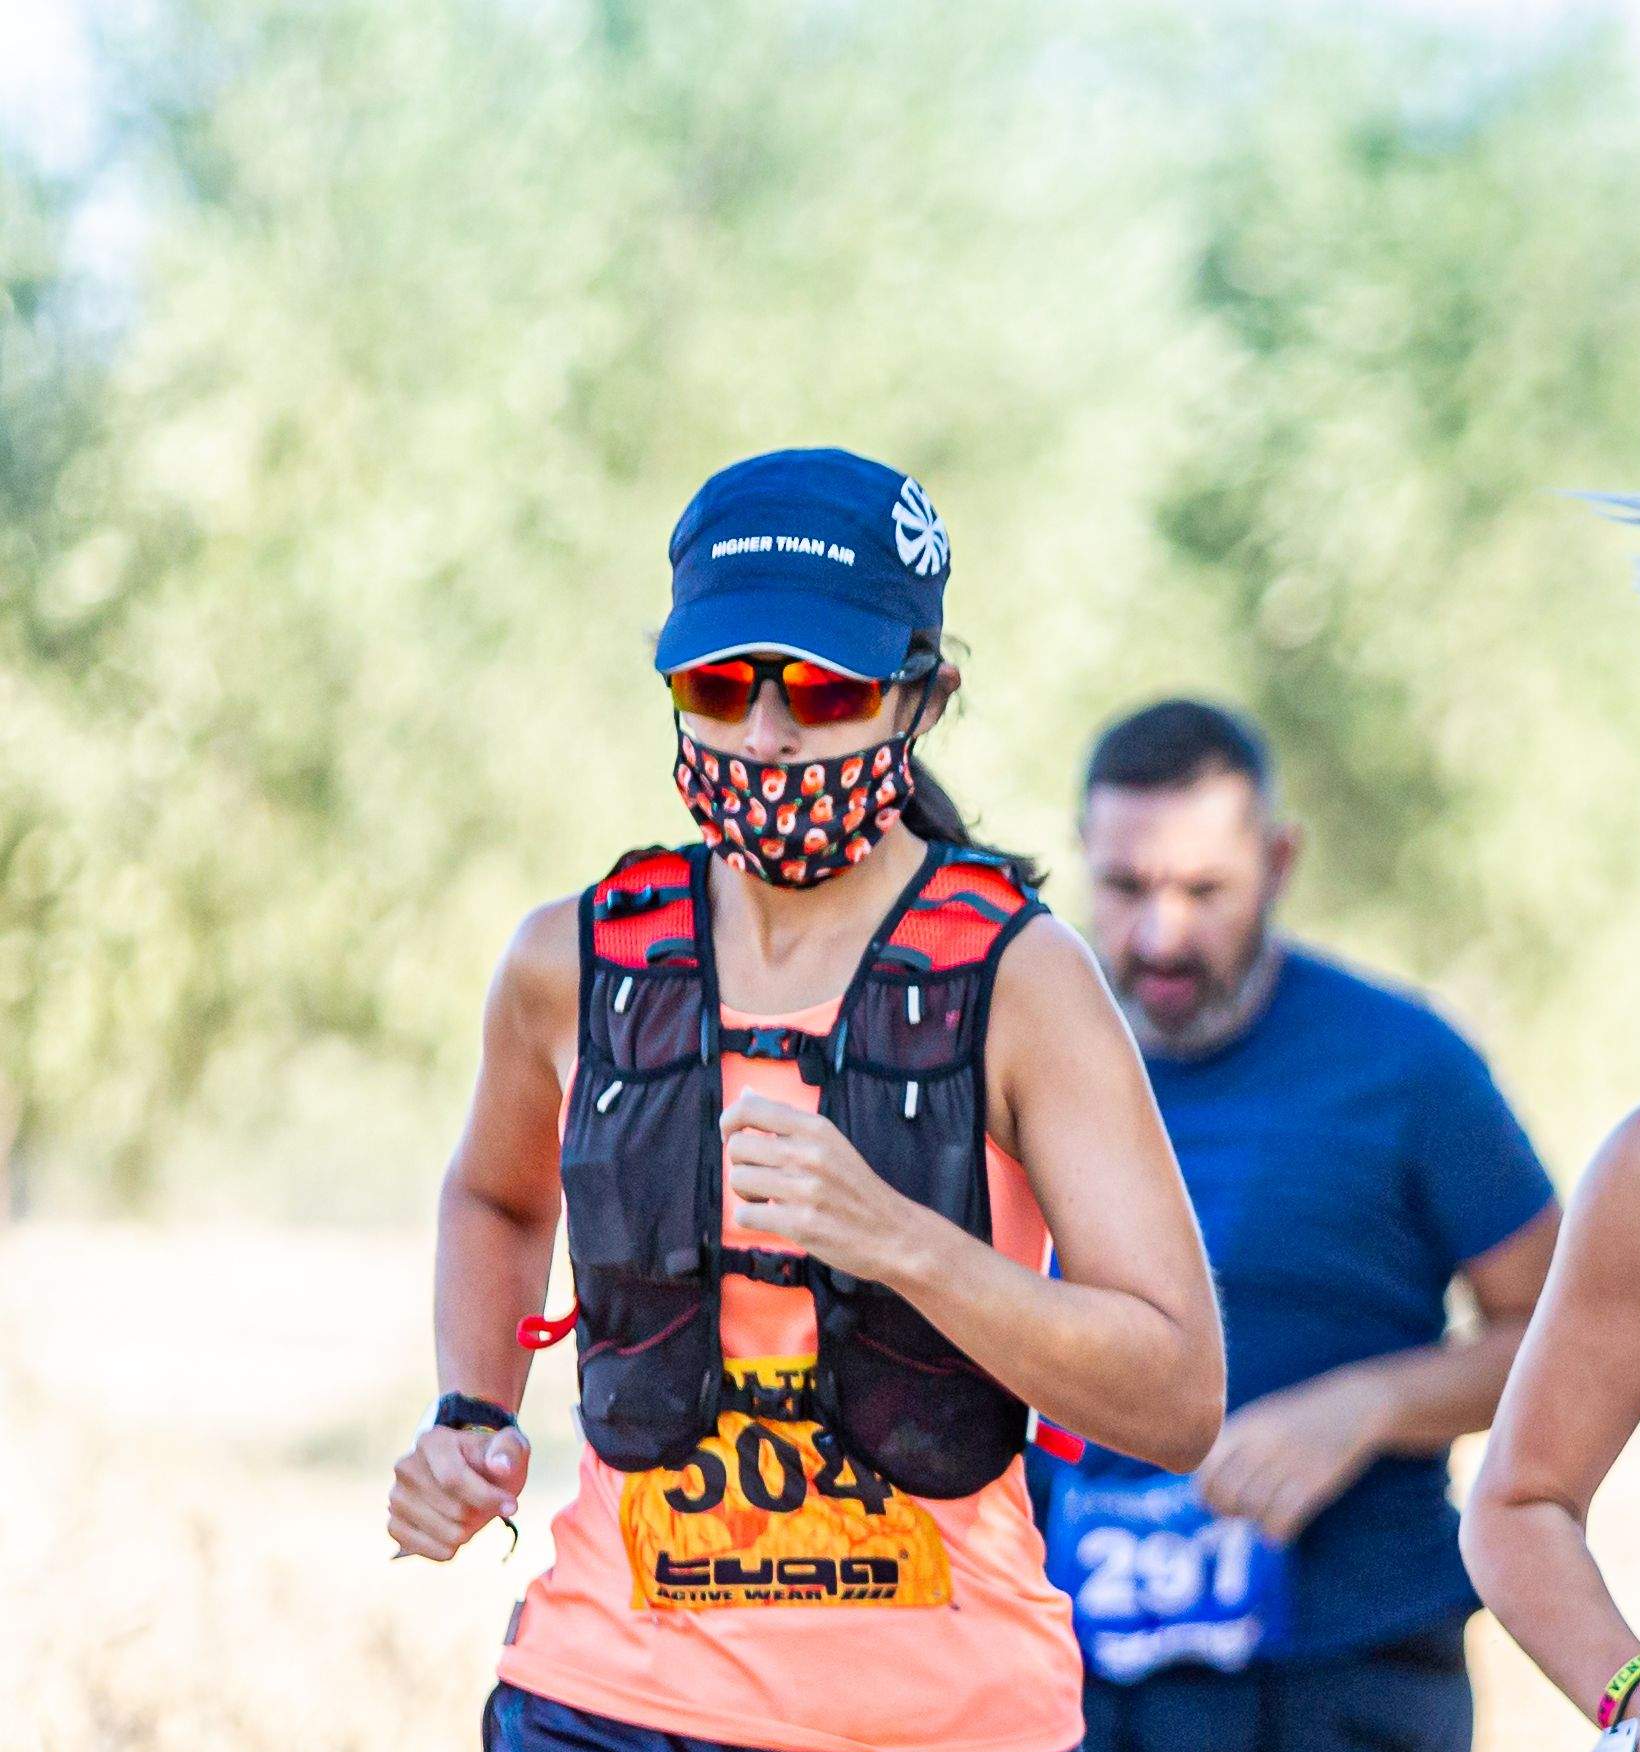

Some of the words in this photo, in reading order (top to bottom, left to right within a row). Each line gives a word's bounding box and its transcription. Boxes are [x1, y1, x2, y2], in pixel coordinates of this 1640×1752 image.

[711, 535, 773, 559] HIGHER
[776, 536, 825, 557] THAN
[827, 543, 856, 567] AIR
[744, 1587, 823, 1601] WEAR
